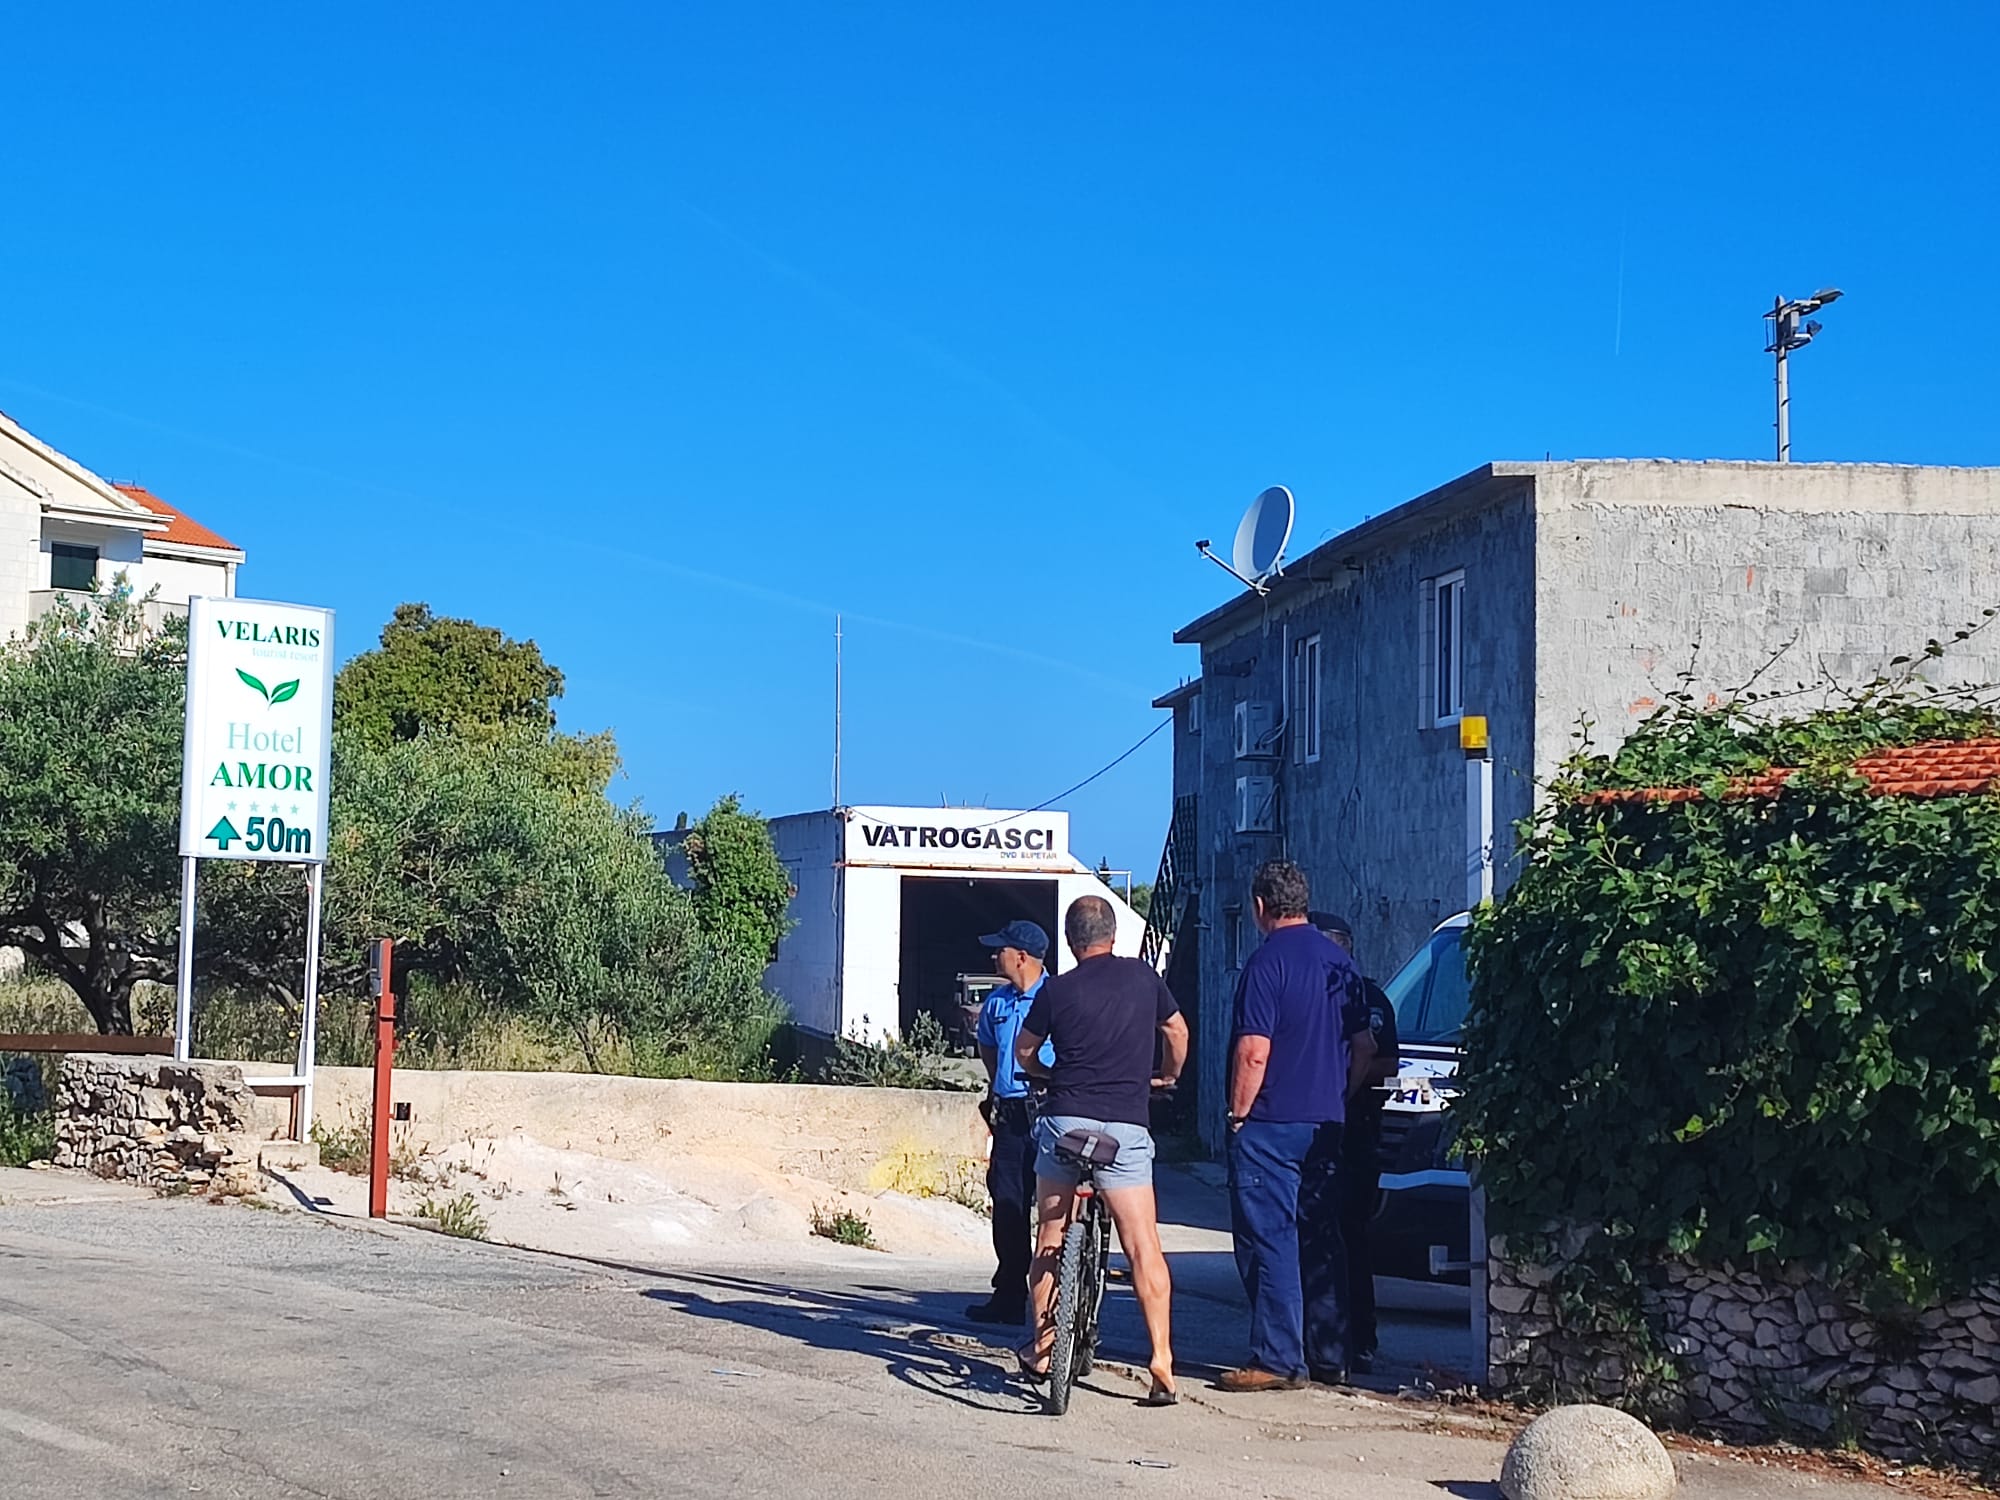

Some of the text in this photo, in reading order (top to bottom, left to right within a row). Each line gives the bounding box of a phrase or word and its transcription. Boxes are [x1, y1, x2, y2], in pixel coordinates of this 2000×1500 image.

[217, 620, 320, 648] VELARIS
[227, 722, 302, 754] Hotel
[210, 761, 313, 792] AMOR
[245, 816, 311, 853] 50m
[862, 825, 1053, 851] VATROGASCI
